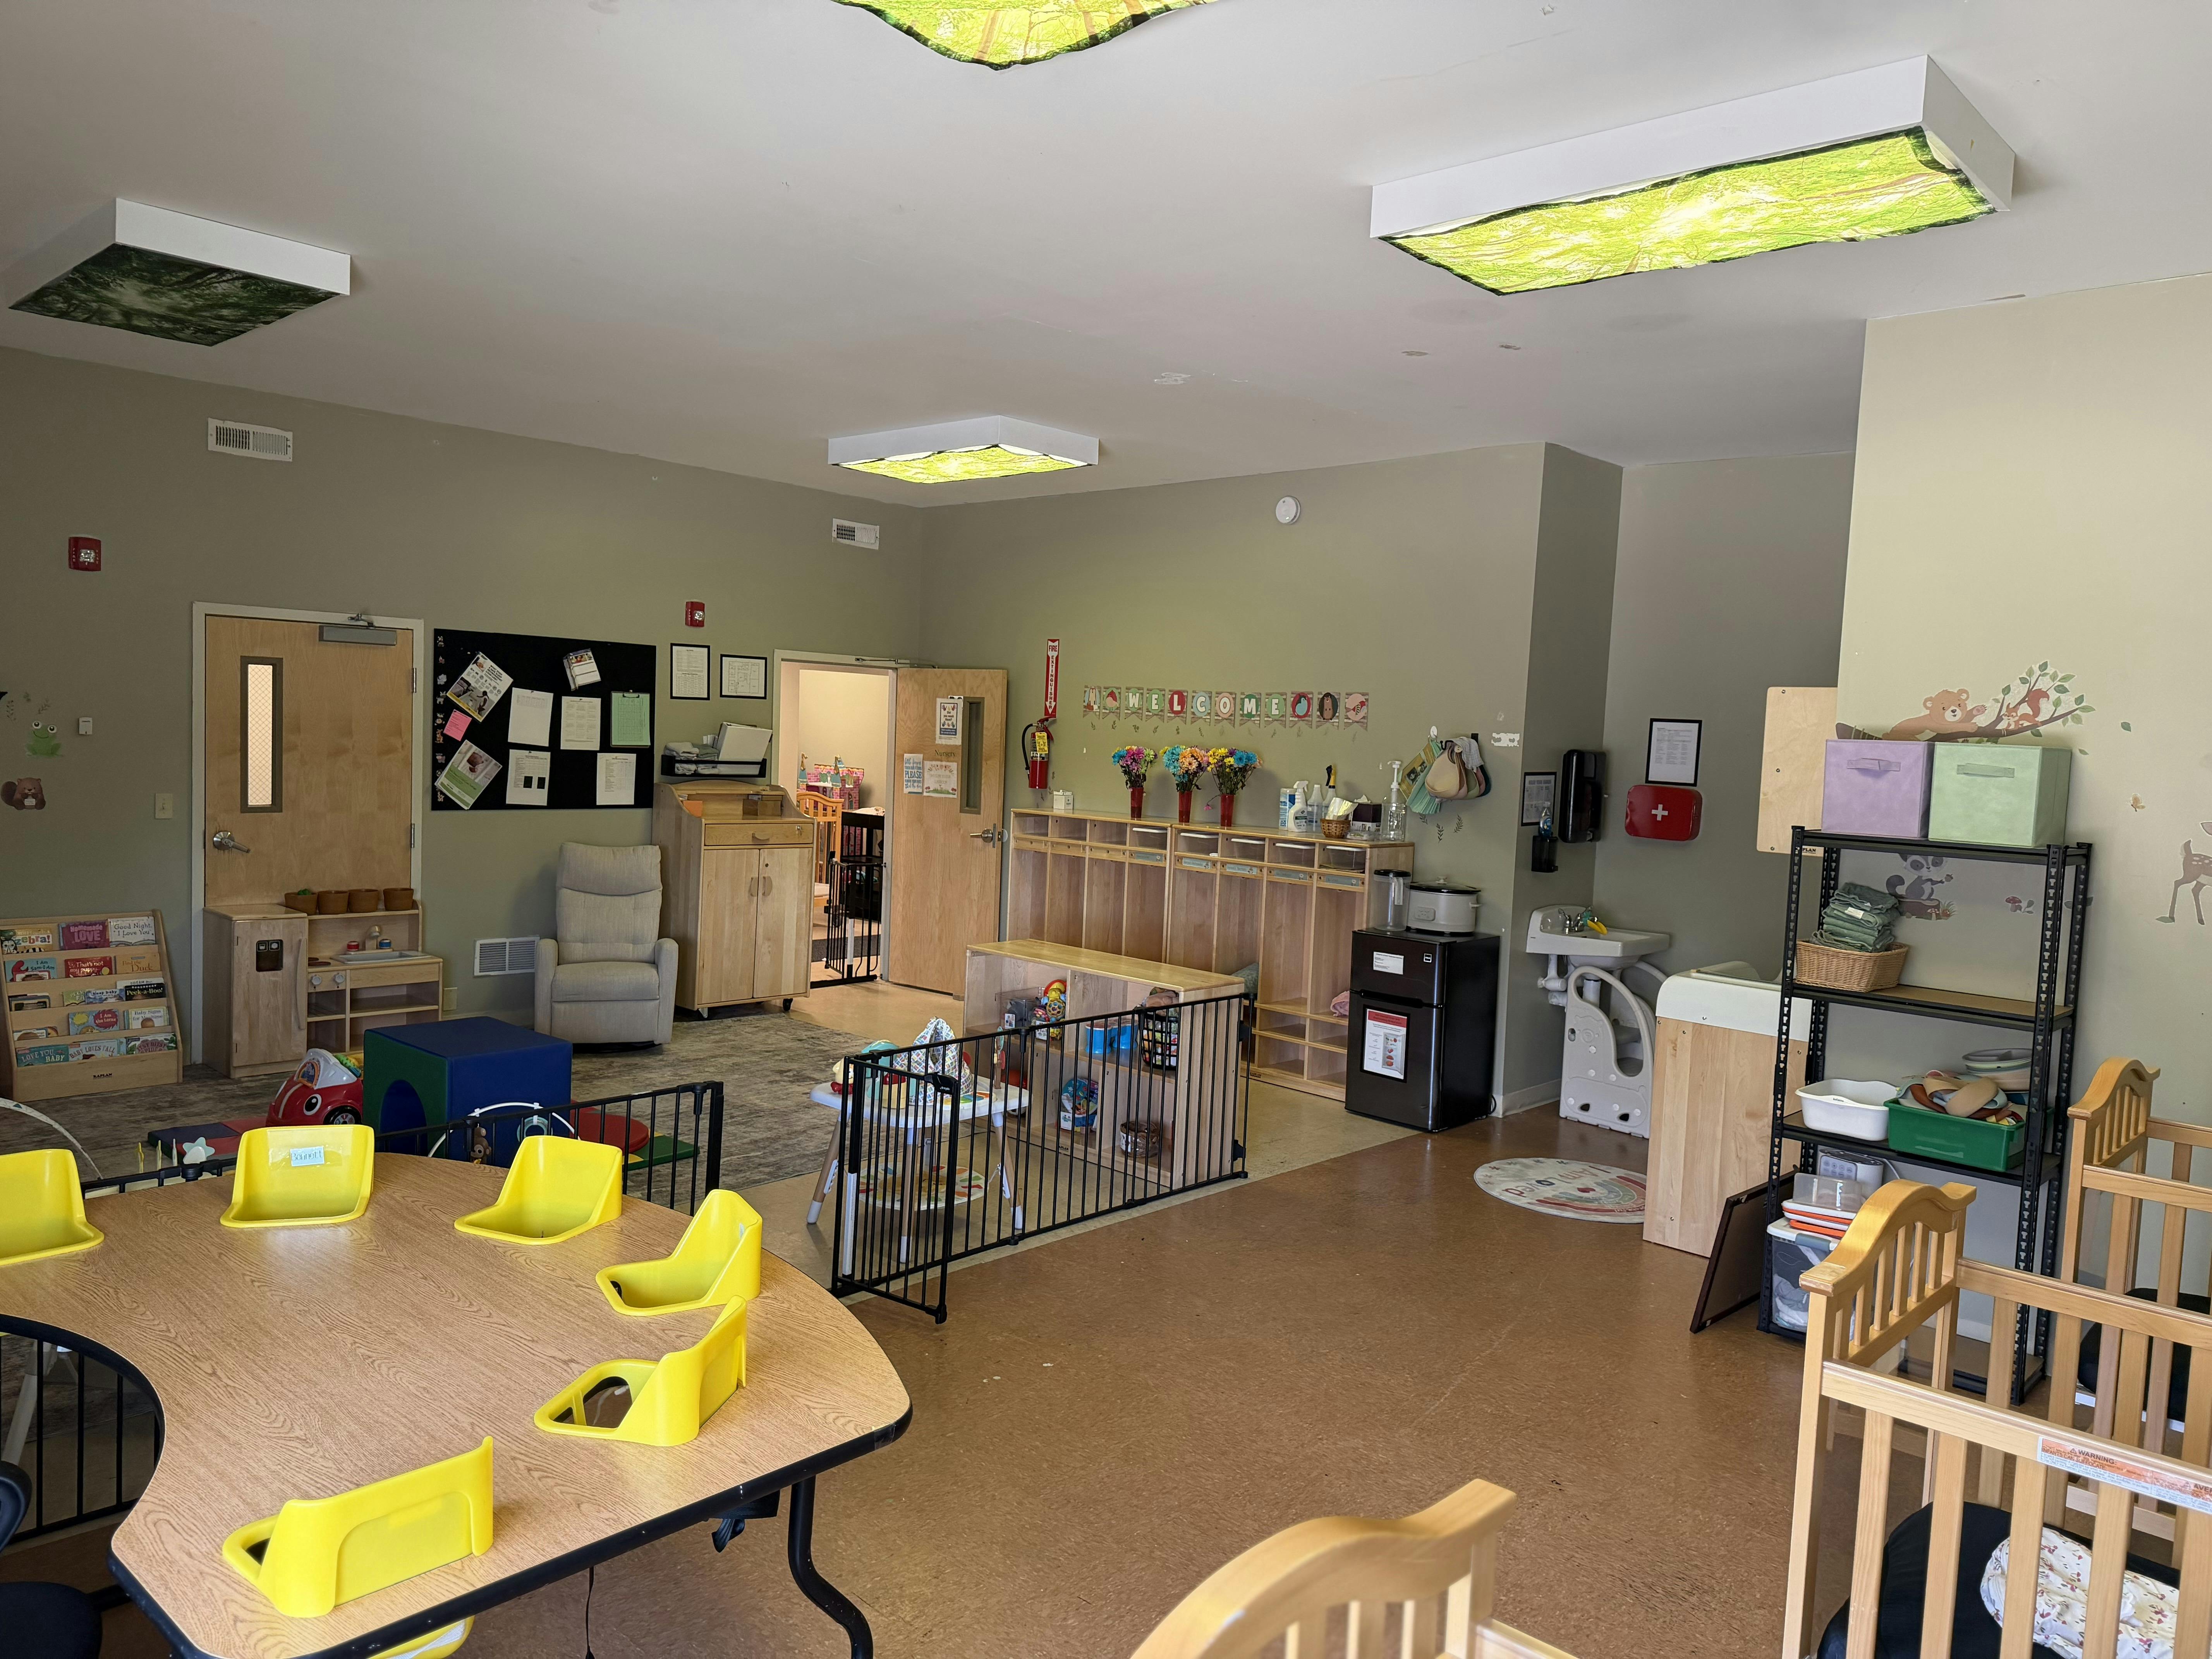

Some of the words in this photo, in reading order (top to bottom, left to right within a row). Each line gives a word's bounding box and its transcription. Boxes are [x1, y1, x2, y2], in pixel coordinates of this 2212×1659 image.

[1128, 692, 1279, 715] WELCOME
[905, 770, 922, 778] PLEASE
[15, 935, 50, 945] zebra!
[74, 930, 101, 942] LOVE
[132, 963, 154, 972] Duck
[21, 1051, 39, 1062] LOVE
[46, 1054, 65, 1063] BABY
[69, 1049, 84, 1059] BABY
[1501, 1176, 1571, 1198] Loved
[2078, 1449, 2117, 1465] WARNING:
